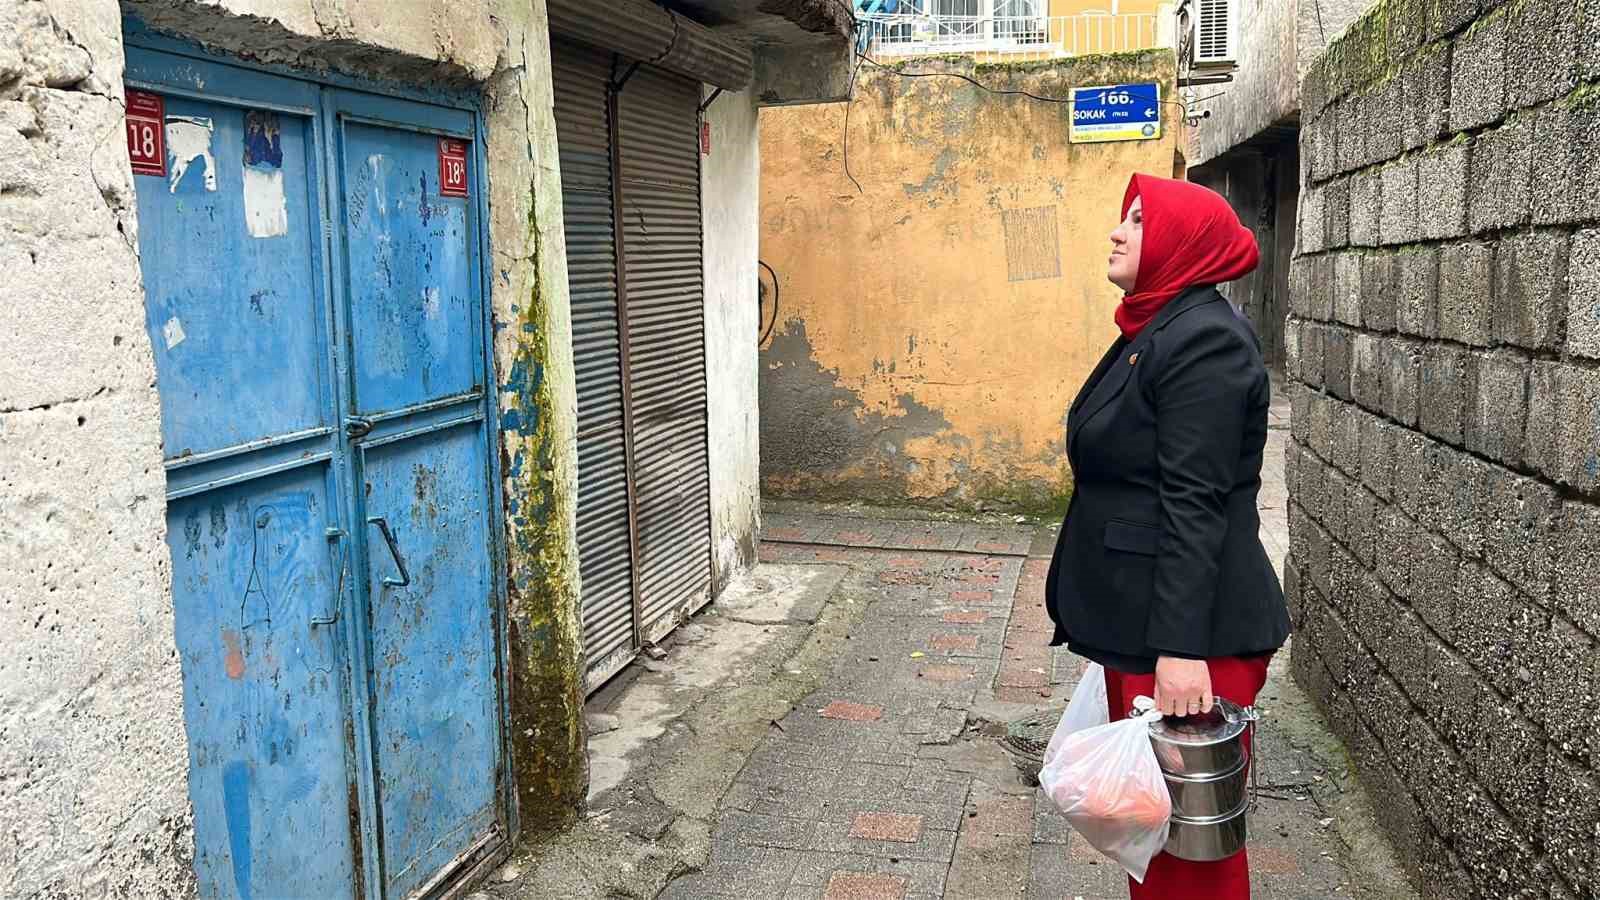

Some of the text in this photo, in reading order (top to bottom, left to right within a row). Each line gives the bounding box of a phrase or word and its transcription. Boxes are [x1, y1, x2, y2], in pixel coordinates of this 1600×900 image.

[1097, 91, 1135, 105] 166.
[1073, 109, 1106, 120] SOKAK
[130, 125, 155, 158] 18
